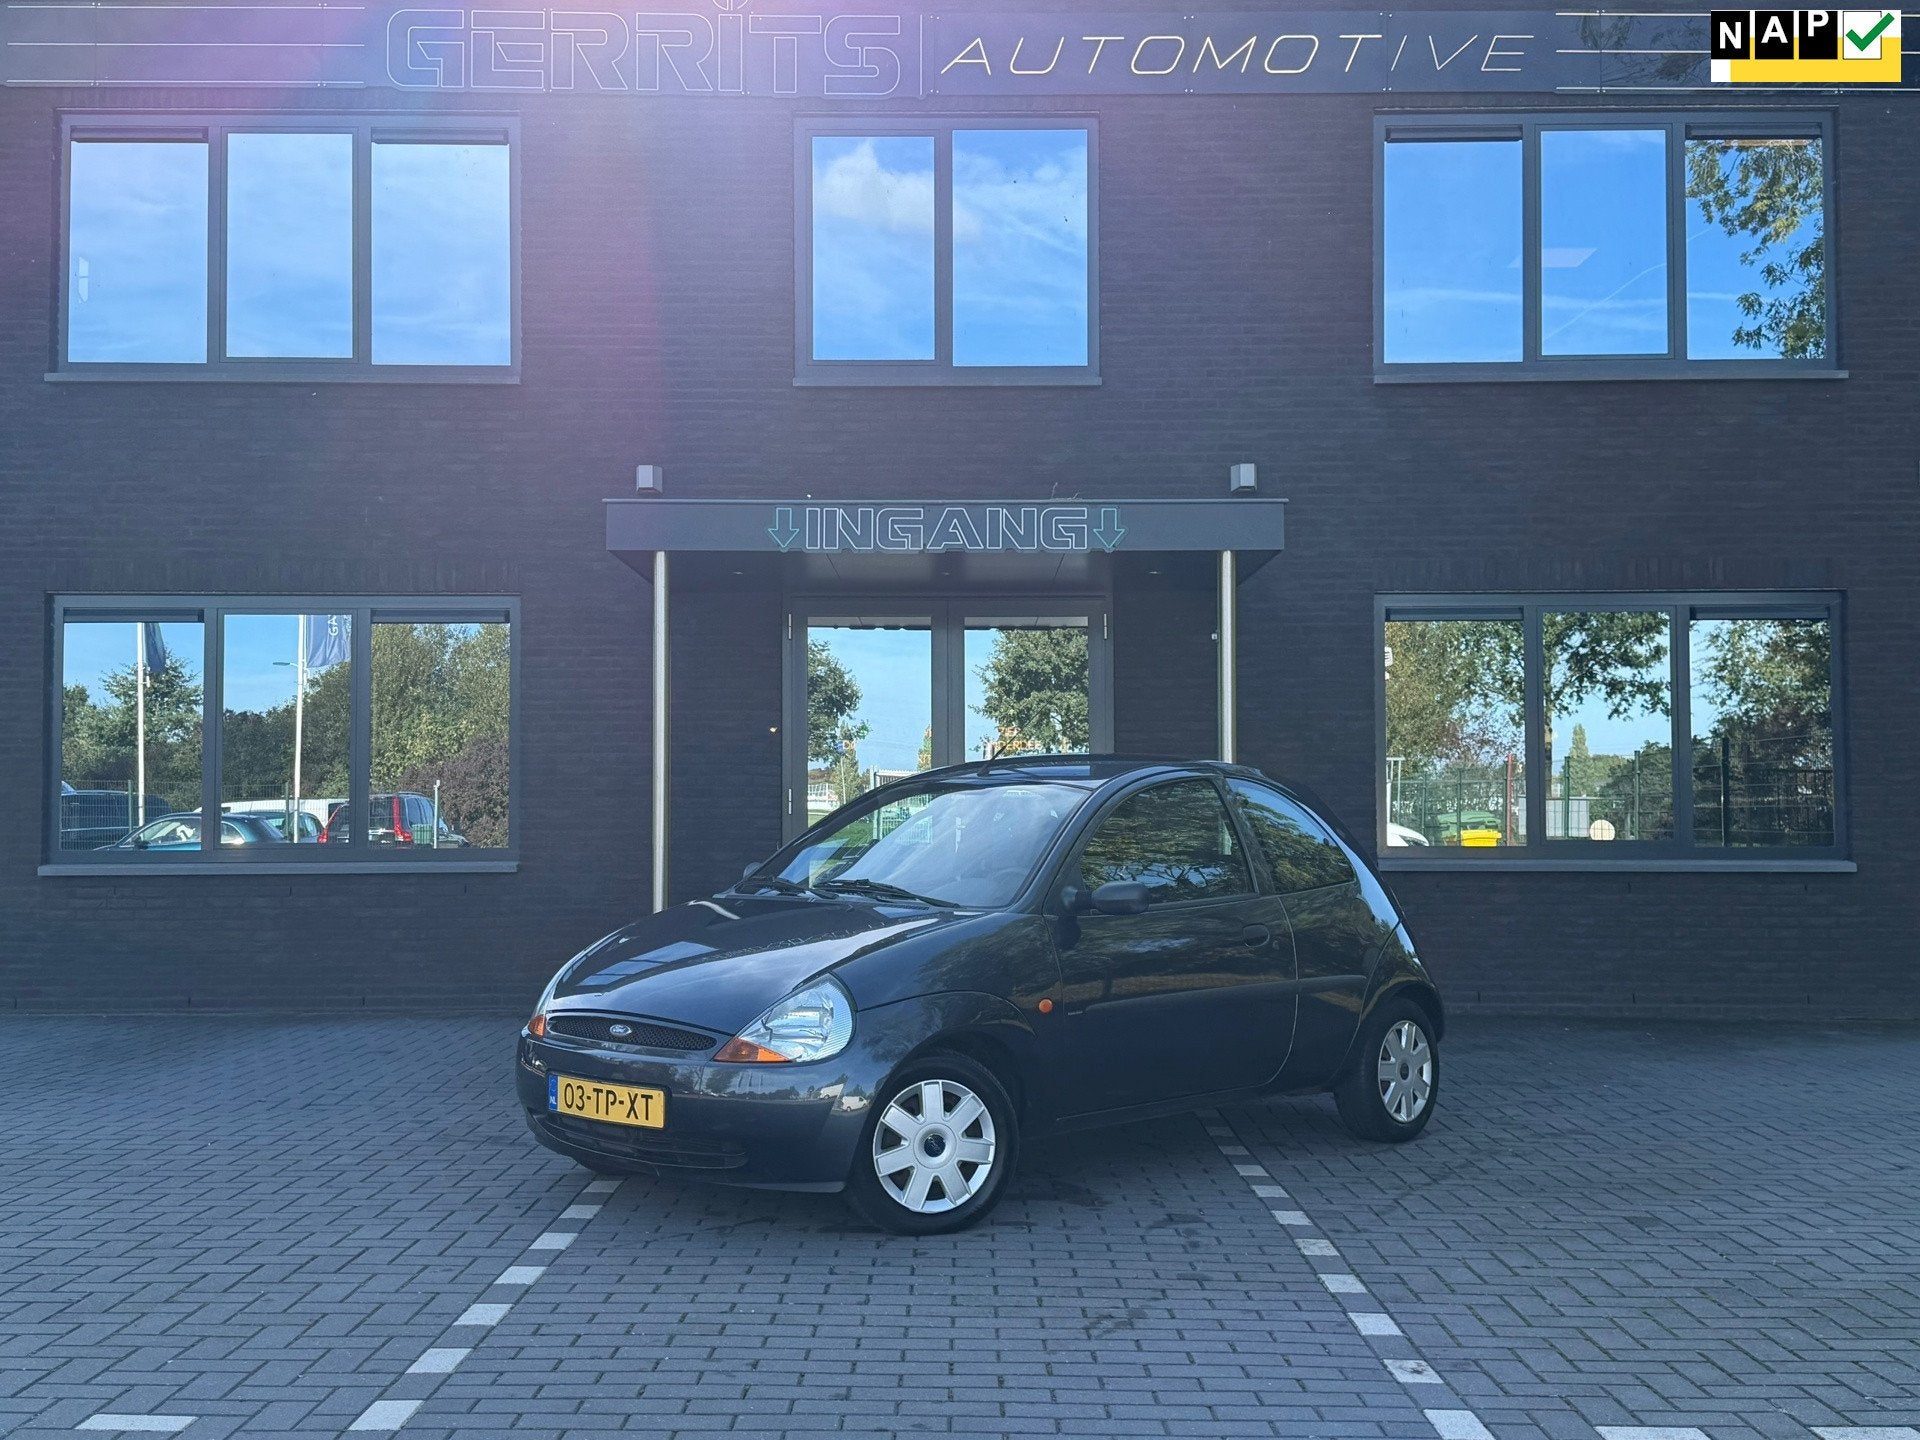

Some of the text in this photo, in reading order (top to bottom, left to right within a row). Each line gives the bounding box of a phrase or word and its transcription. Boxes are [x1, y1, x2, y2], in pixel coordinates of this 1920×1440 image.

[940, 33, 1535, 77] AUTOMOTIVE
[805, 507, 1089, 551] INGANG
[563, 1082, 655, 1121] 03-TP-XT
